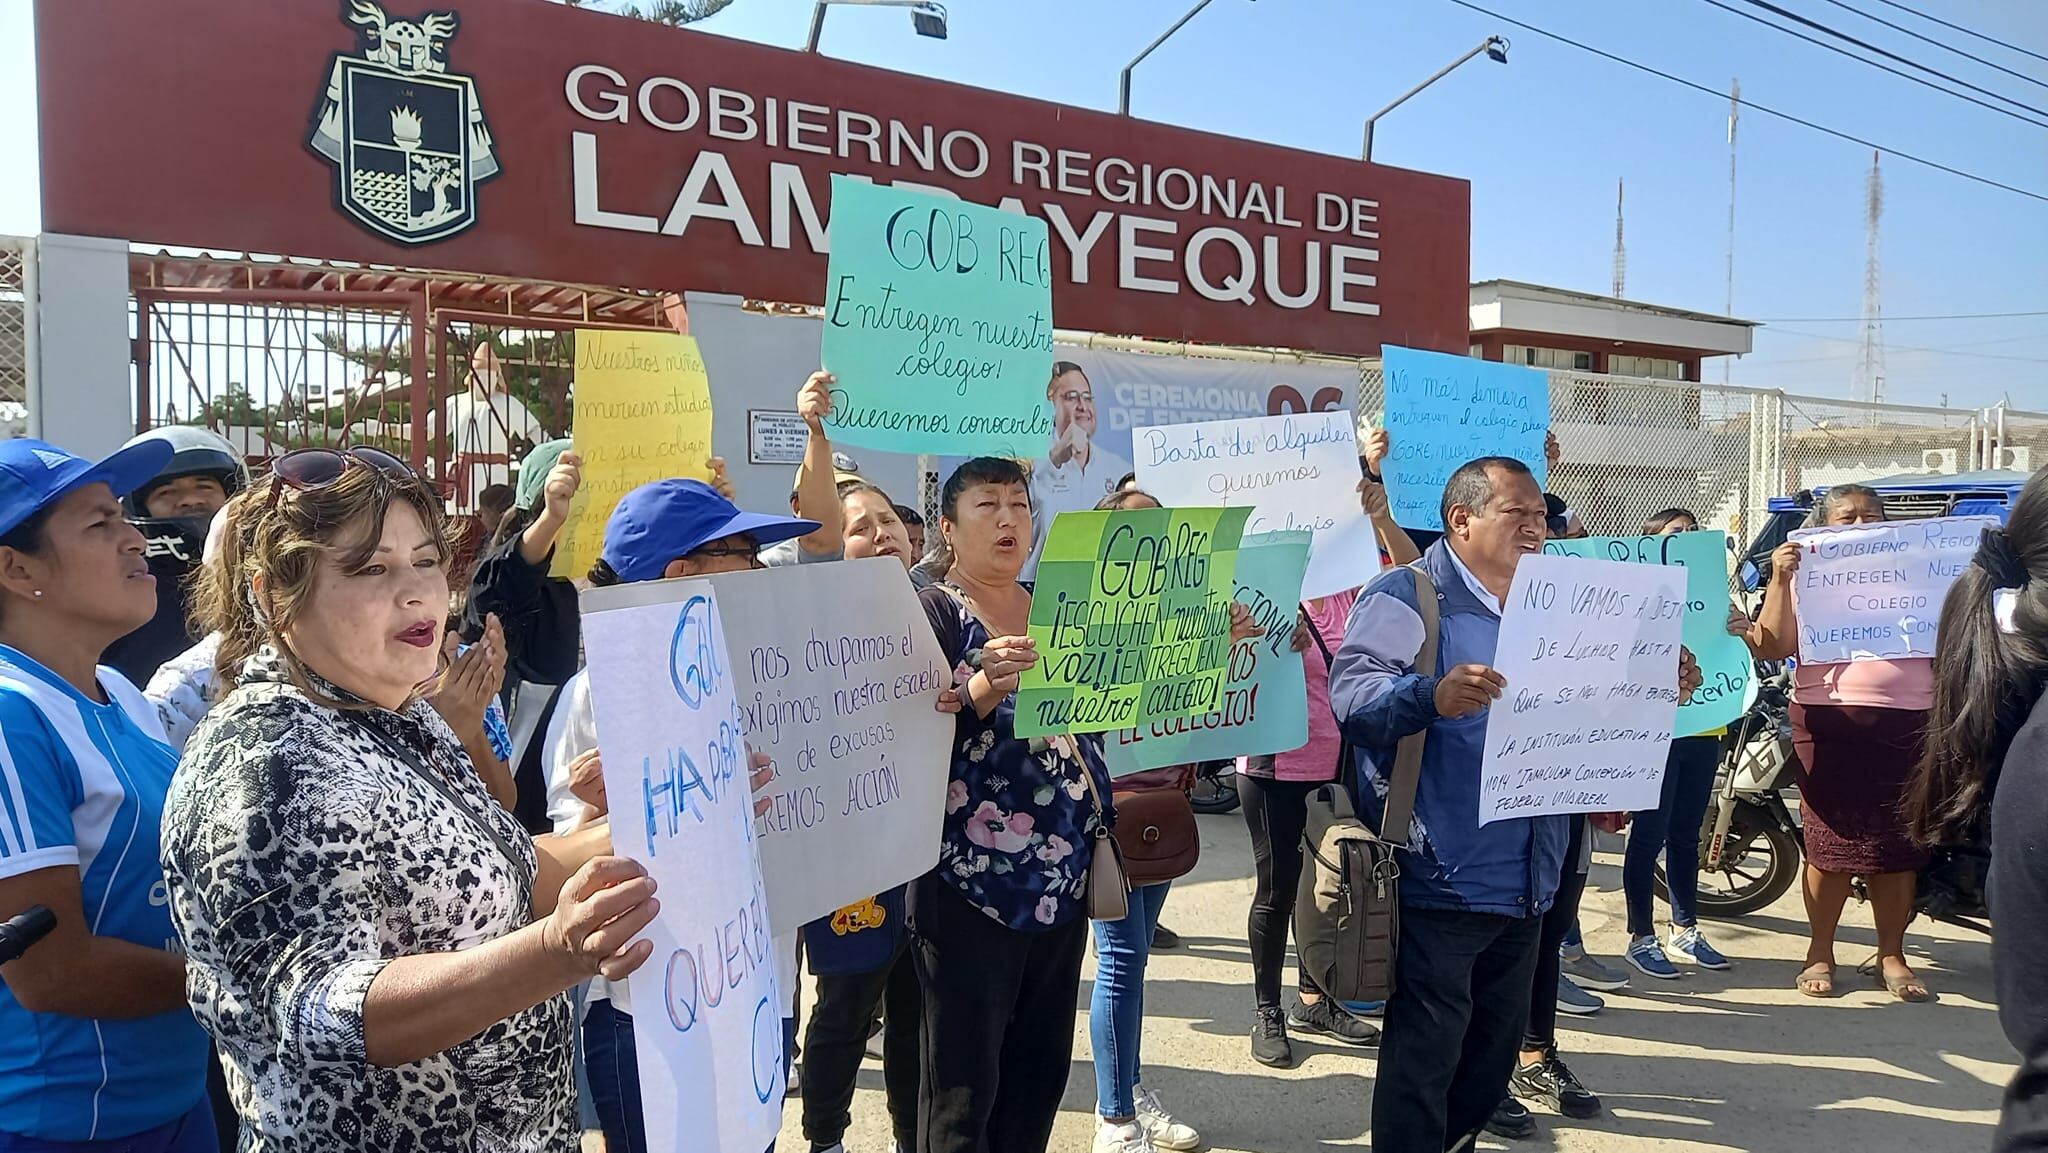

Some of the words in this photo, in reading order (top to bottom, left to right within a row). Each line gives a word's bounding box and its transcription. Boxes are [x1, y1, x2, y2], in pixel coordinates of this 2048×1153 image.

[564, 65, 989, 179] GOBIERNO
[1011, 140, 1309, 230] REGIONAL
[1318, 192, 1381, 240] DE
[570, 130, 1381, 317] LAMYEQUE
[831, 275, 963, 355] Entregen
[579, 331, 661, 373] Nuestros
[895, 341, 1003, 397] colegio!
[823, 389, 950, 435] Queremos
[1113, 382, 1265, 413] CEREMONIA
[1471, 375, 1529, 411] demora
[1108, 407, 1145, 431] DE
[1144, 429, 1221, 467] Basta
[1228, 432, 1255, 458] de
[1170, 523, 1209, 590] REG
[1523, 578, 1556, 611] NO
[1570, 582, 1631, 621] VAMOS
[1634, 596, 1649, 619] A
[1806, 569, 1908, 589] ENTREGEN
[1172, 588, 1229, 644] nuestra
[1847, 594, 1928, 612] COLEGIO
[750, 646, 790, 685] nos
[805, 626, 895, 680] chupamos
[901, 624, 914, 658] el
[1532, 636, 1557, 661] DE
[1628, 640, 1673, 660] HASTA
[1801, 624, 1892, 648] QUEREMOS
[834, 680, 887, 719] nuestra
[893, 660, 941, 701] escuela
[1036, 684, 1139, 727] nuestro
[1146, 671, 1222, 717] COLEGIO!
[1513, 687, 1543, 714] QUE
[1554, 687, 1573, 704] SE
[1607, 681, 1643, 701] HAGA
[796, 738, 818, 773] de
[830, 721, 896, 760] excusas
[1497, 734, 1516, 759] LA
[1520, 727, 1583, 756] INSTITUCIÓN
[1587, 728, 1650, 744] EDUCATIVA
[757, 784, 826, 840] REMOS
[841, 753, 901, 817] ACCIÓN
